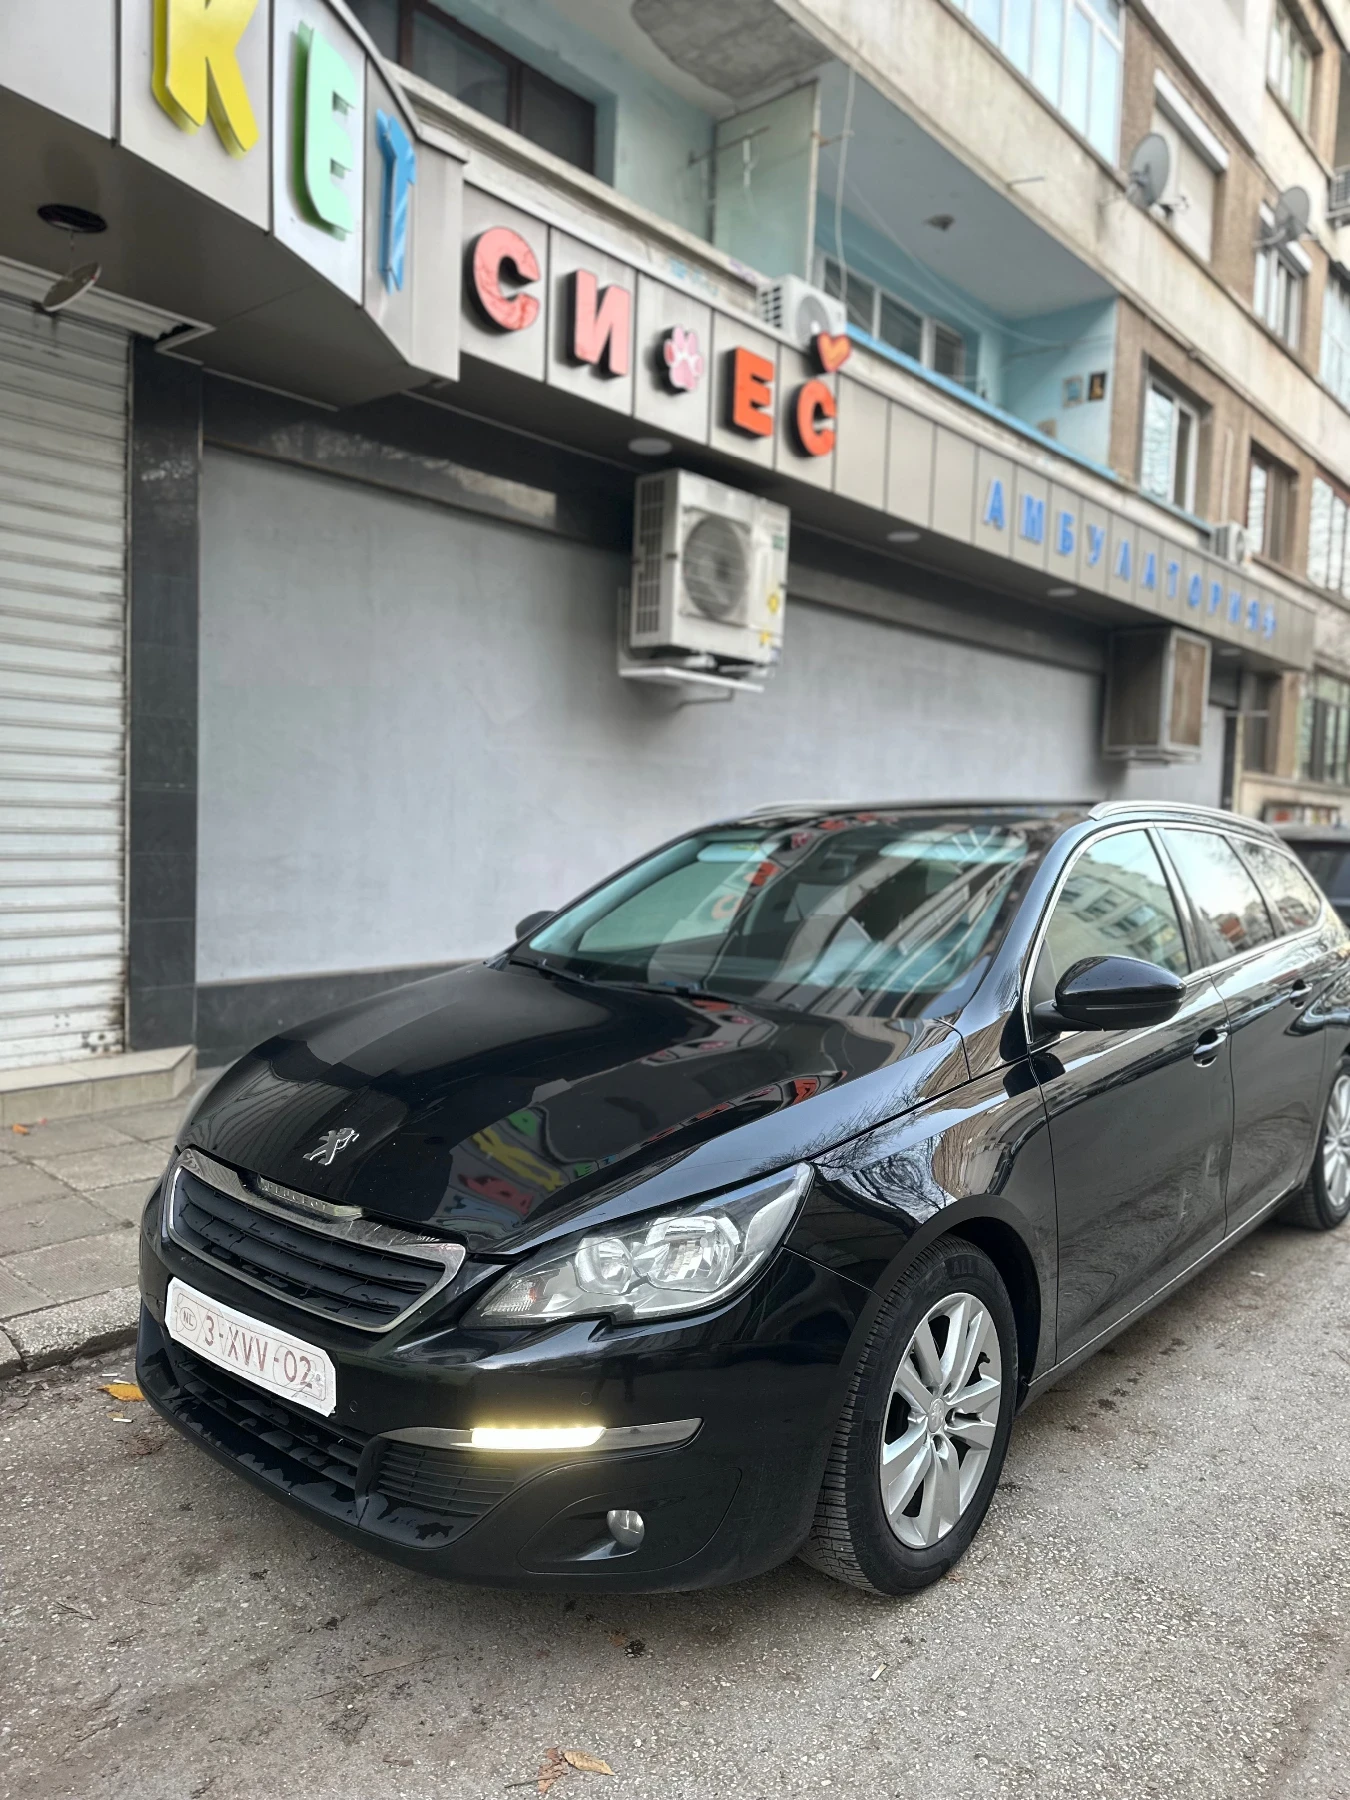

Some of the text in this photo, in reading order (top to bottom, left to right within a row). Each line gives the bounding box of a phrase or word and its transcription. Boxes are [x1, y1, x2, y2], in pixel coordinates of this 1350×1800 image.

[470, 226, 837, 458] СИ ЕС
[984, 478, 1261, 632] АМБУЛАТОРИЯ
